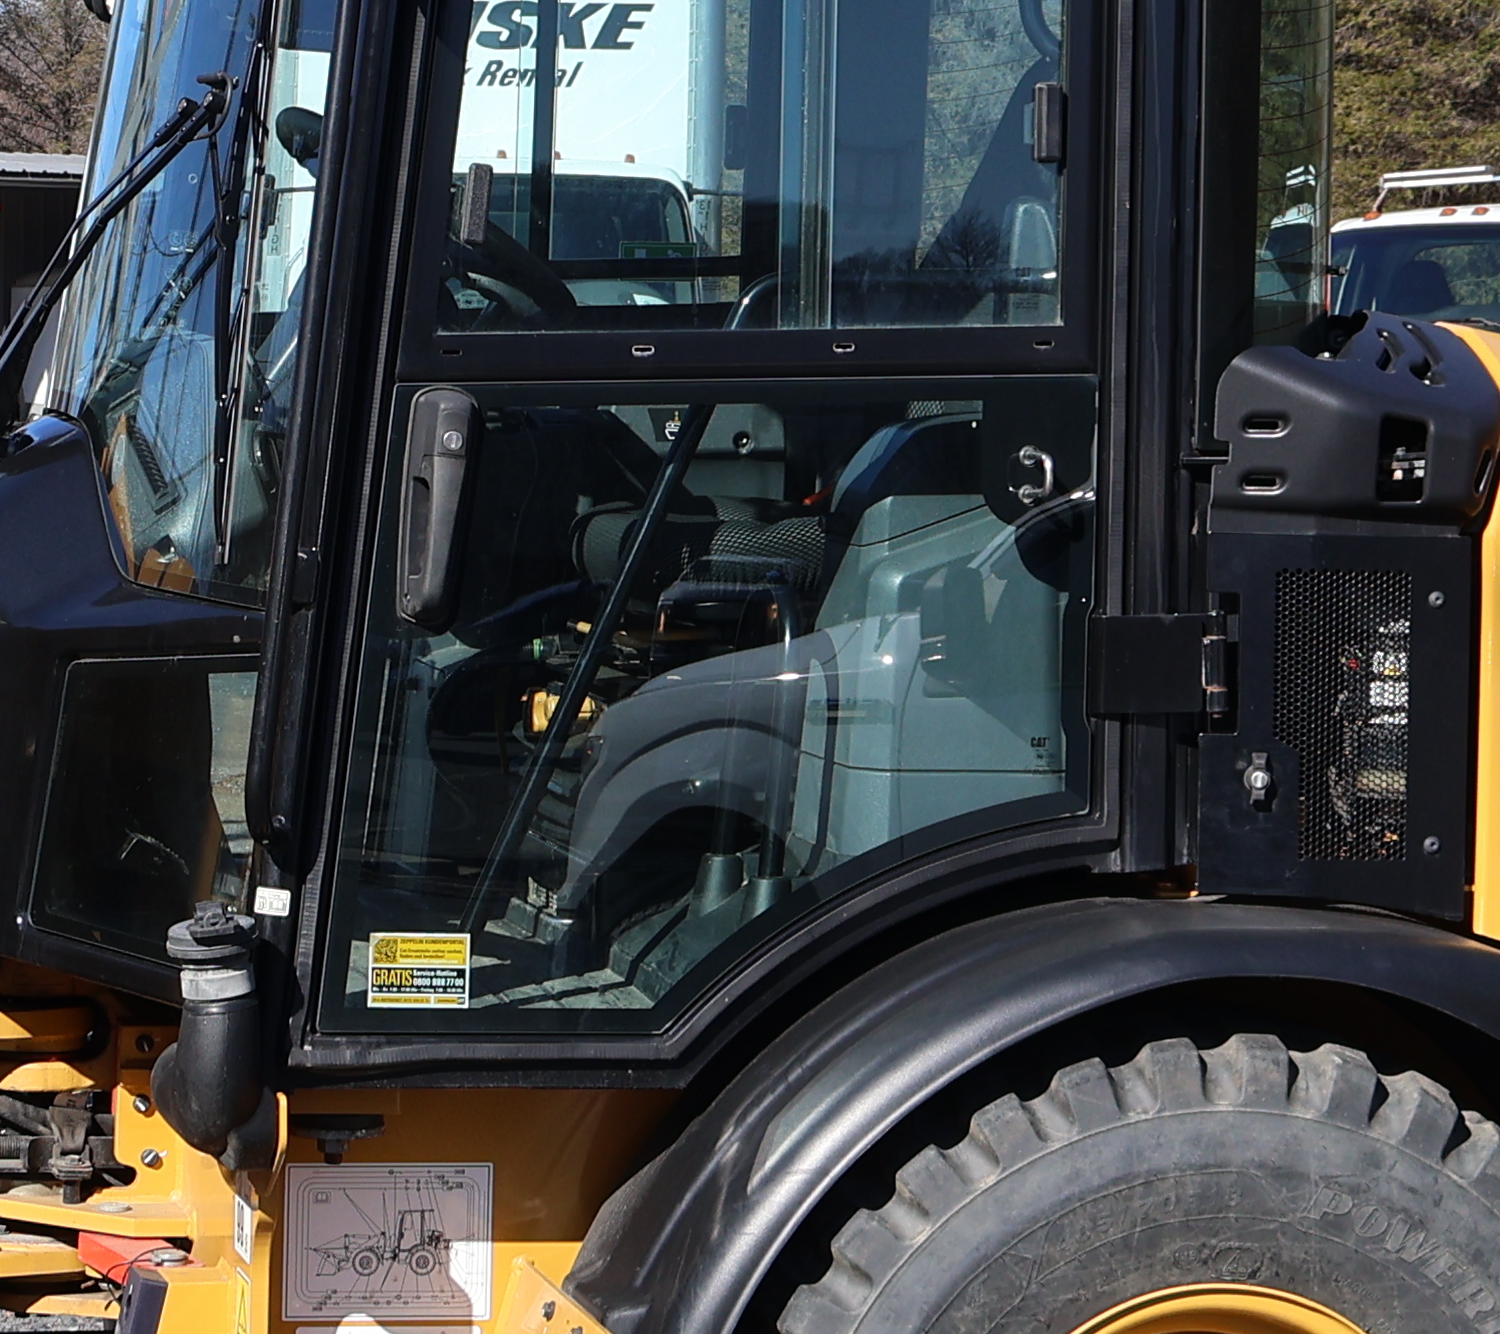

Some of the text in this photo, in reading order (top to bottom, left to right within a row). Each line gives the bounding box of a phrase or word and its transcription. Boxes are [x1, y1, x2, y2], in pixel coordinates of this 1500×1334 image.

[476, 59, 585, 89] Renal
[1030, 736, 1048, 748] CAT
[373, 969, 412, 986] GRATIS
